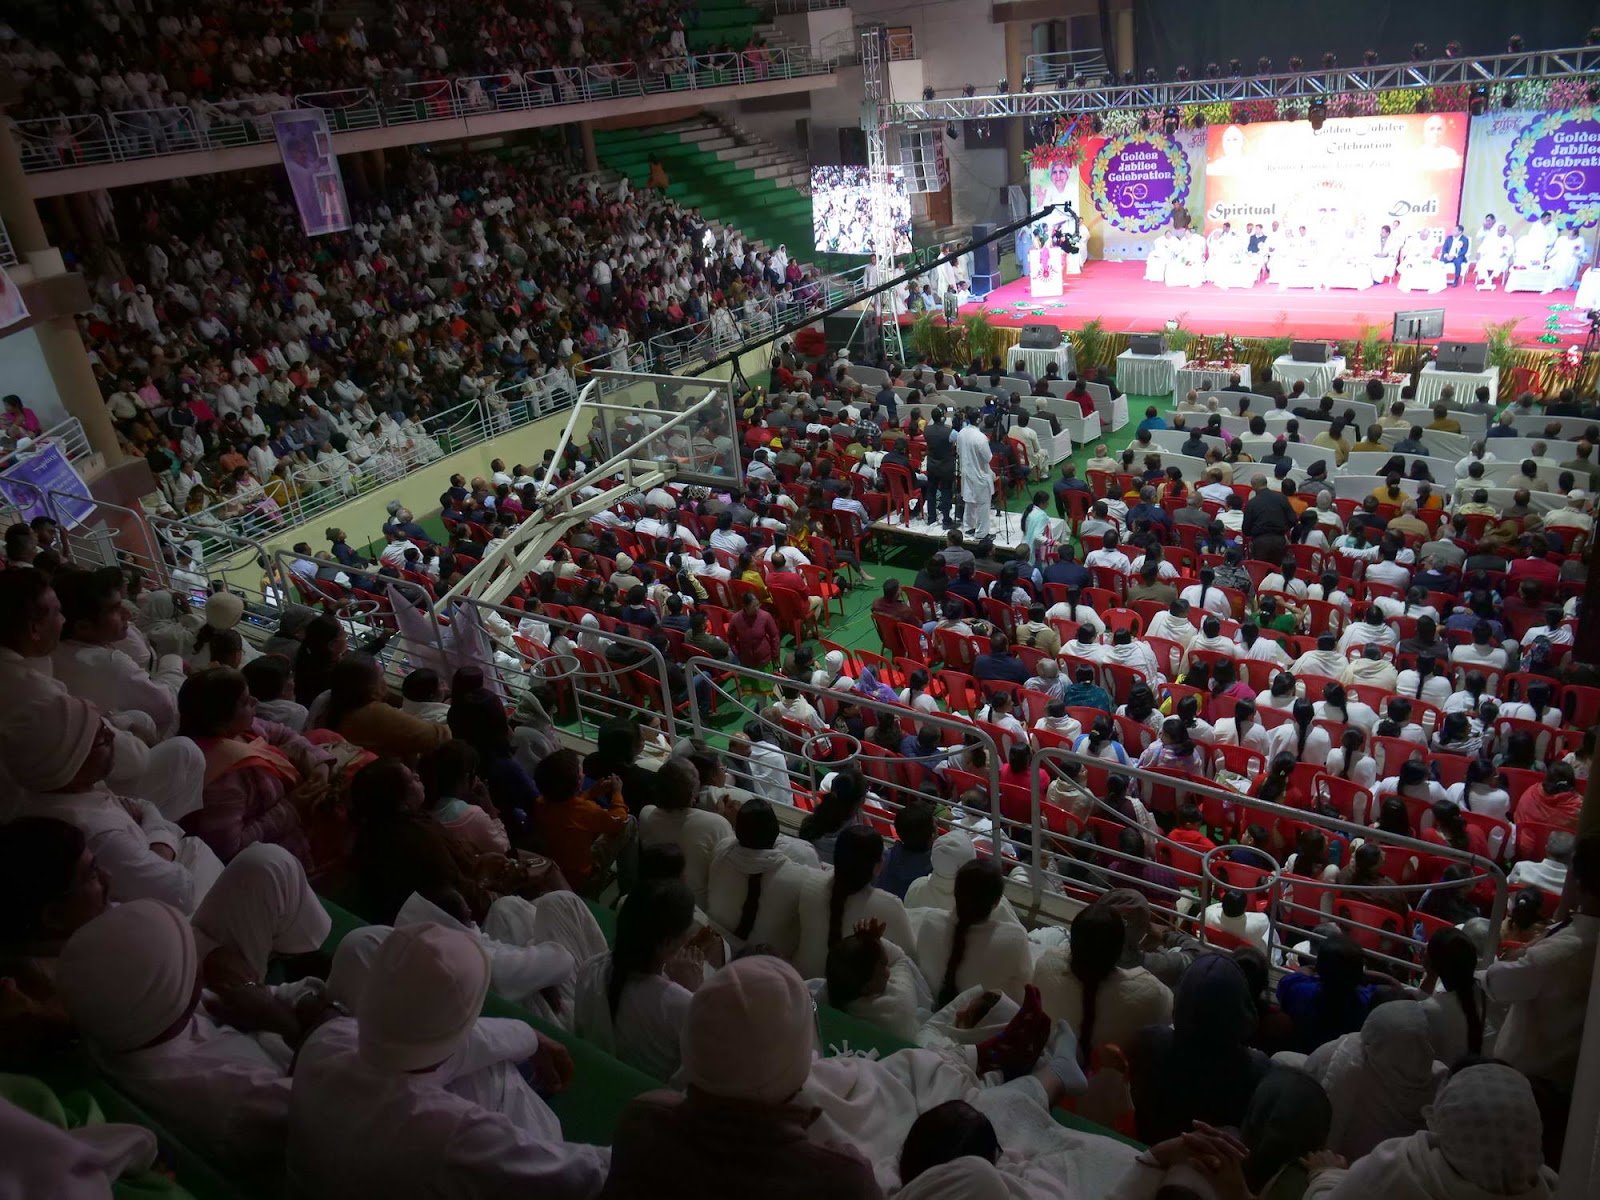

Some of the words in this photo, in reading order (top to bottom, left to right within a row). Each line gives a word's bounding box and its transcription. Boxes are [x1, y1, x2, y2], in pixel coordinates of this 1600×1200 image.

[1120, 152, 1158, 161] Golden
[1118, 162, 1157, 172] Jubilee
[1544, 170, 1586, 200] 50
[1120, 183, 1148, 208] 50
[1210, 203, 1276, 219] Spiritual
[1388, 200, 1436, 217] Dadi
